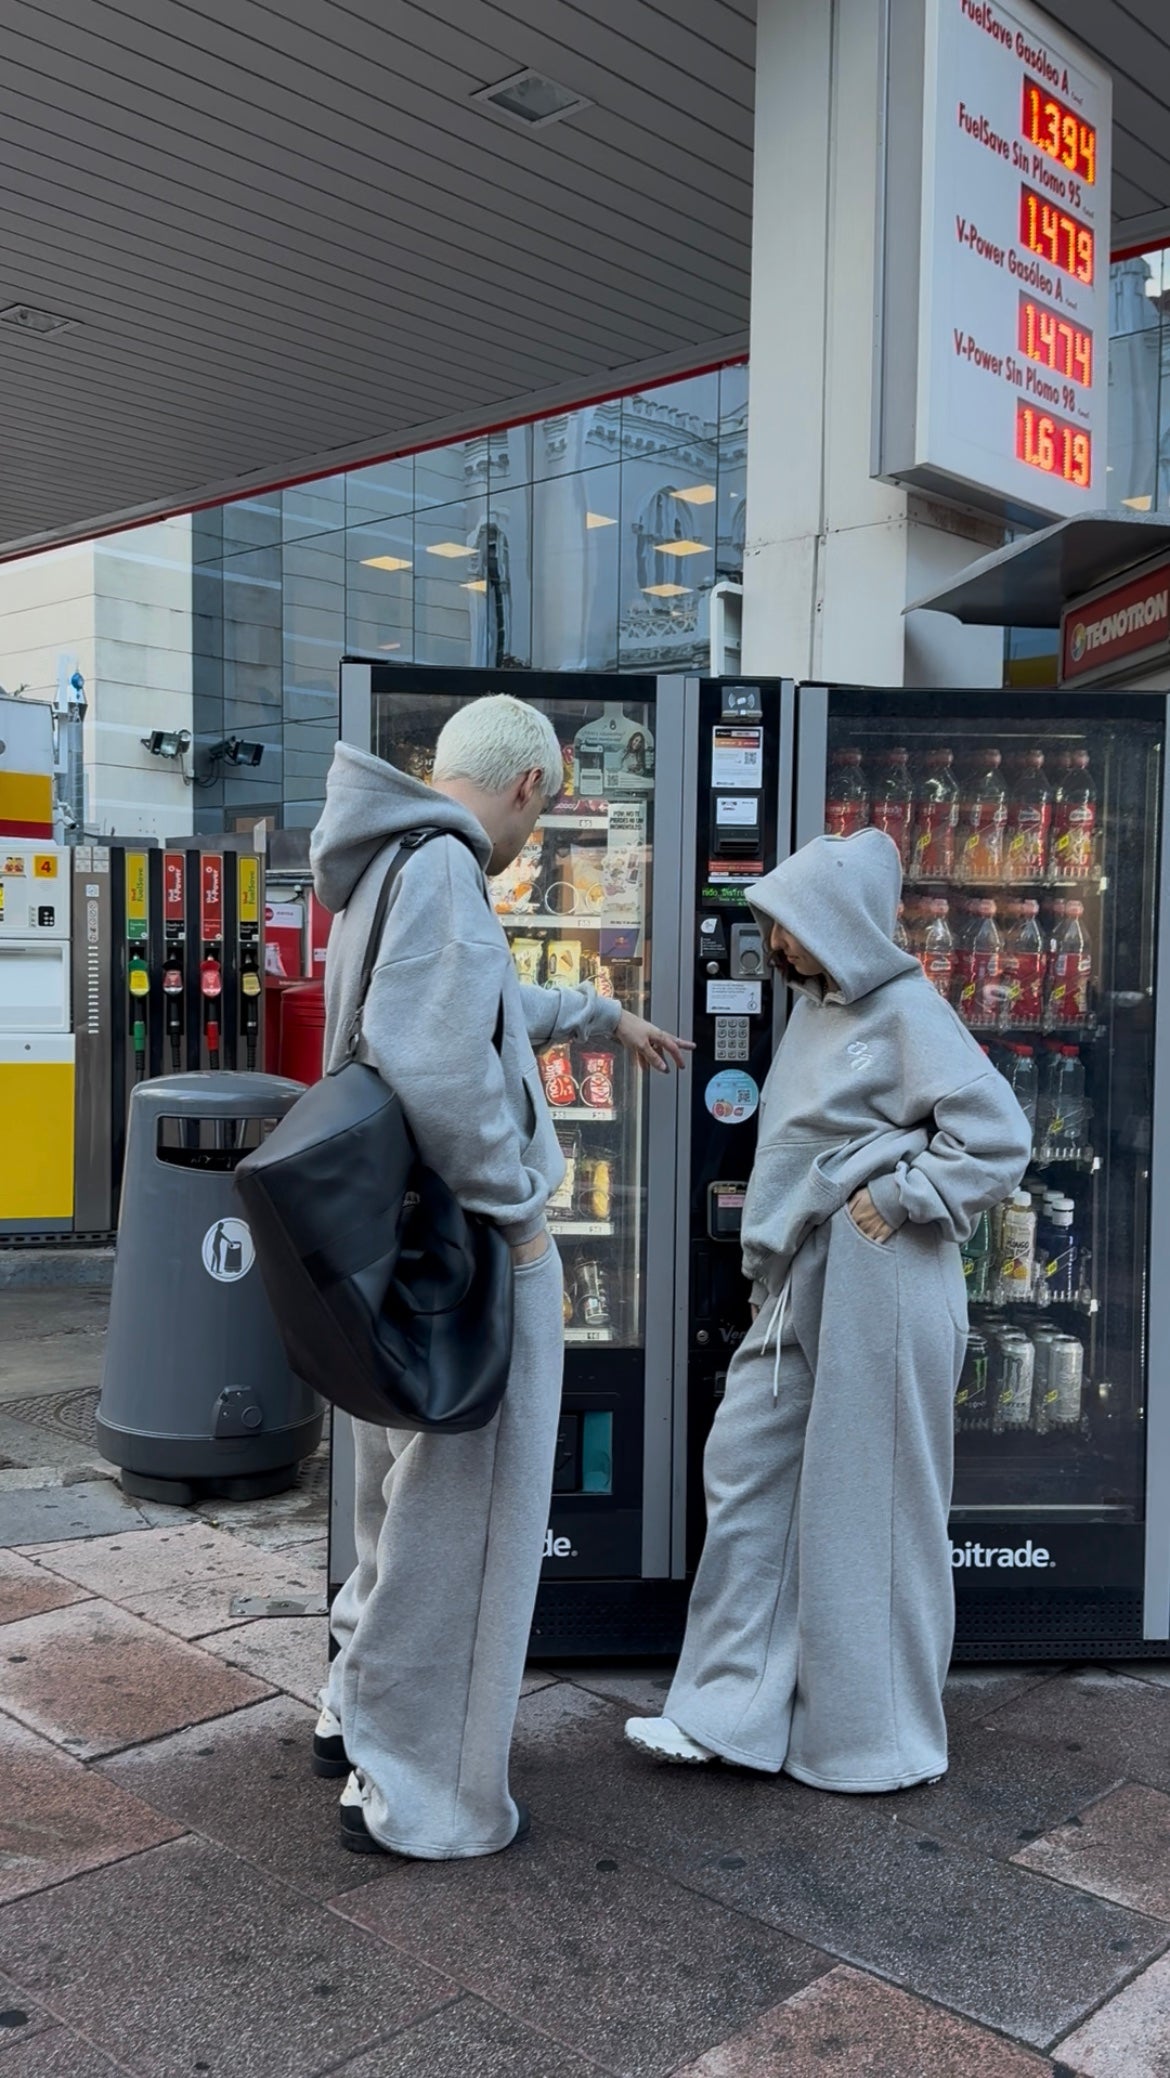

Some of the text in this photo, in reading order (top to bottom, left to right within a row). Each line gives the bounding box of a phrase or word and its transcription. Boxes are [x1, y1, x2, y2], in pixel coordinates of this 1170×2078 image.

[1015, 31, 1059, 86] Gasóleo
[1061, 68, 1069, 95] A
[958, 101, 1081, 208] FuelSave Sin Plomo 95
[1030, 88, 1095, 186] 1.394
[956, 214, 1063, 303] V-Power Gasóleo A
[1028, 195, 1093, 284] 1.479
[954, 328, 1075, 412] V-Power Sin Plomo 98
[1026, 303, 1091, 388] 1.474
[1085, 589, 1168, 651] TECNOTRON
[41, 861, 51, 873] 4
[173, 868, 181, 902] V-Power
[211, 869, 219, 903] V-Power
